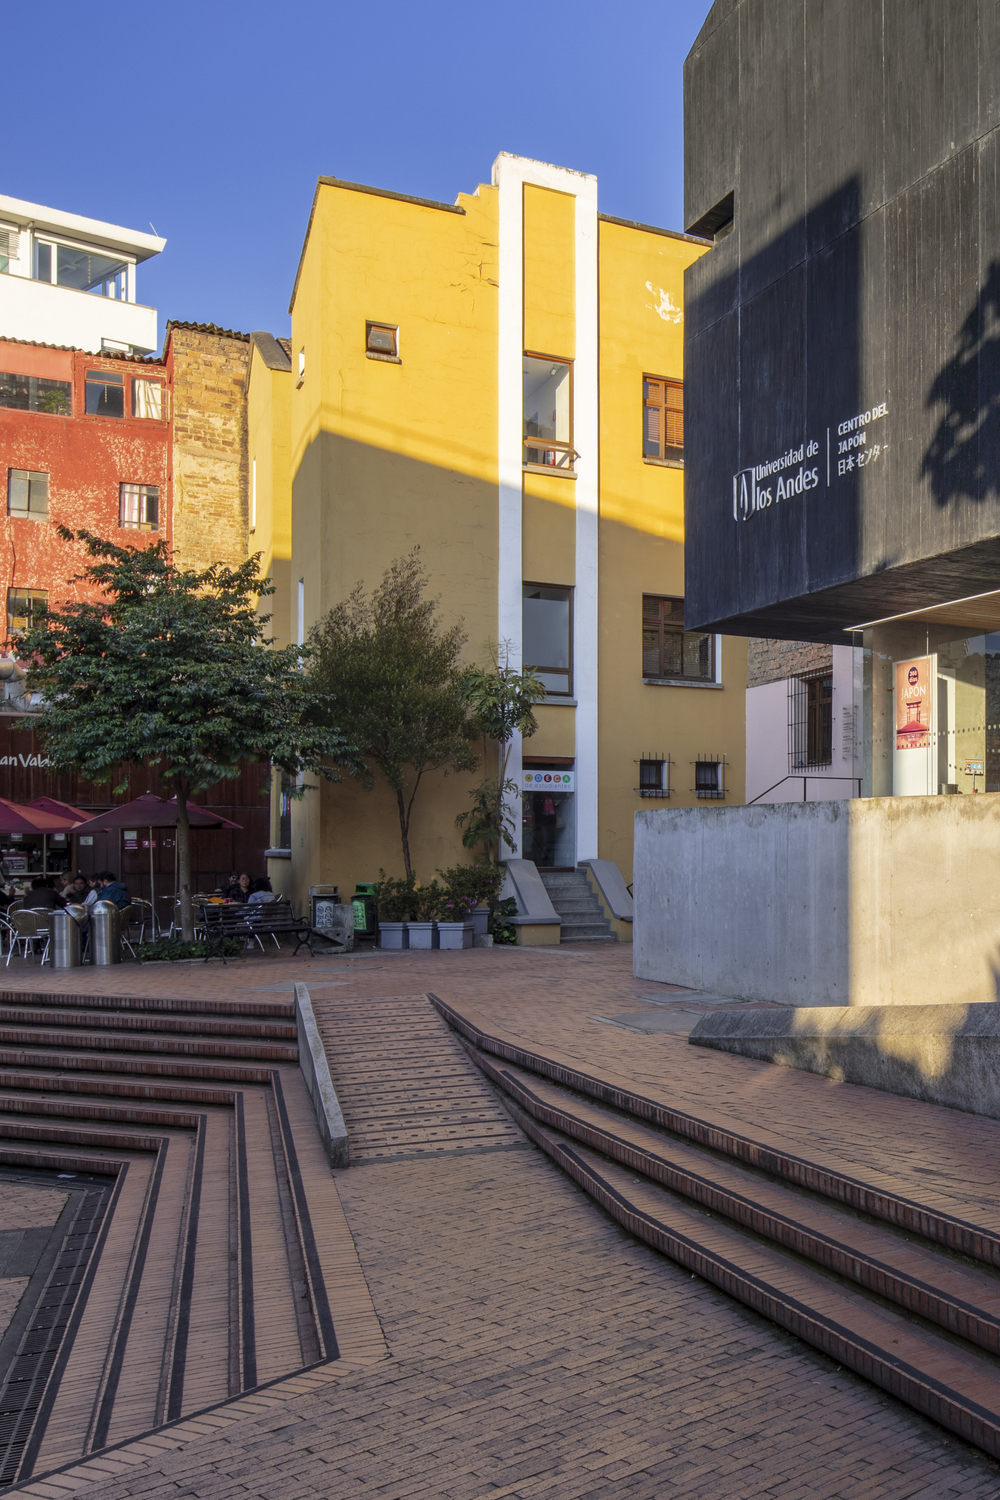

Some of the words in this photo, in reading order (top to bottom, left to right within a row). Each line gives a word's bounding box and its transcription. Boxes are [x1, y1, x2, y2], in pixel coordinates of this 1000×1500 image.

[838, 411, 871, 436] CENTRO
[872, 402, 889, 421] DEL
[838, 430, 867, 455] JAPÓN
[756, 443, 804, 481] Universidad
[806, 439, 819, 457] de
[756, 486, 772, 511] los
[775, 466, 819, 503] Andes
[901, 684, 926, 700] JAPÓN
